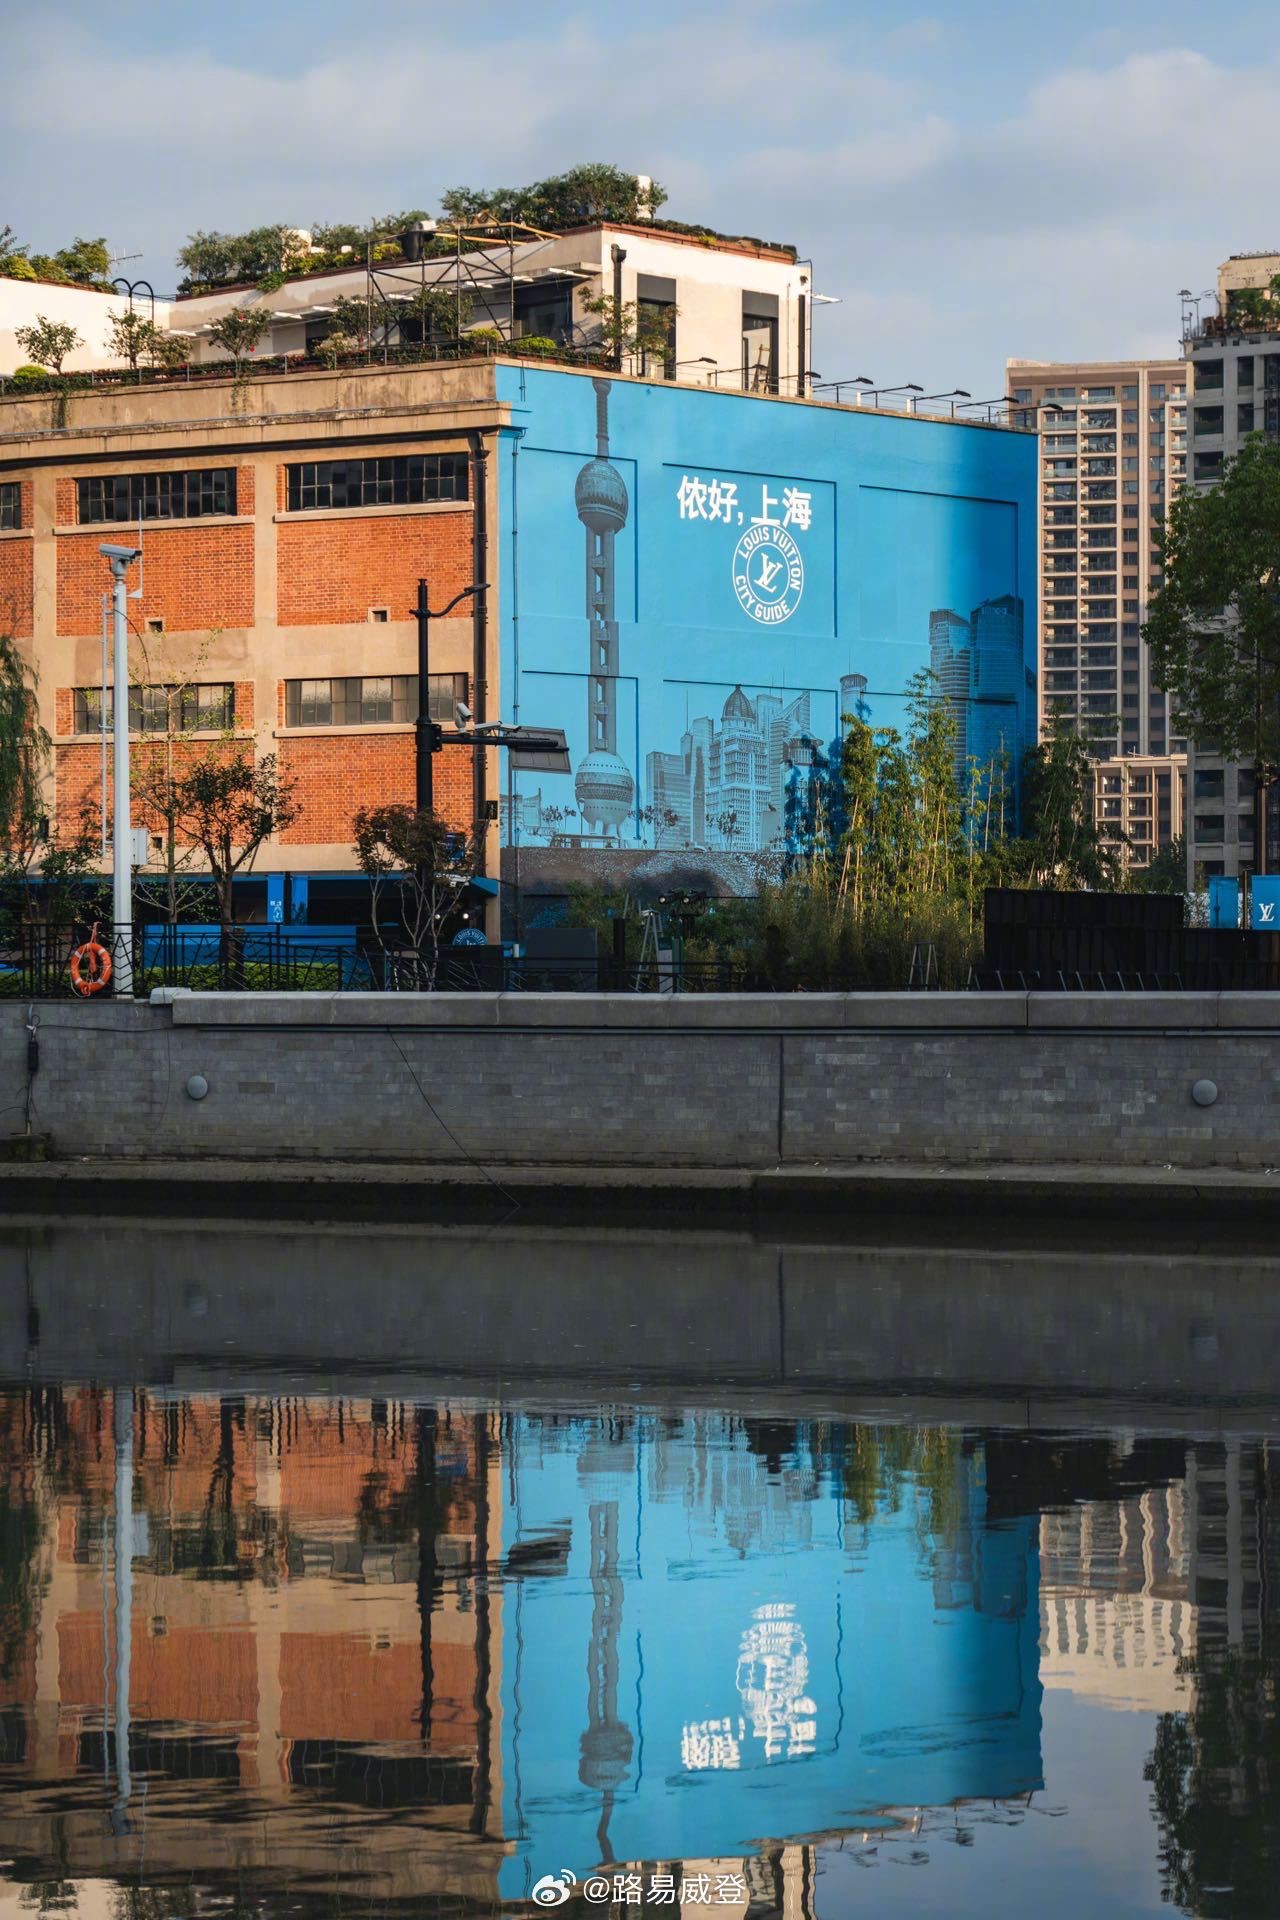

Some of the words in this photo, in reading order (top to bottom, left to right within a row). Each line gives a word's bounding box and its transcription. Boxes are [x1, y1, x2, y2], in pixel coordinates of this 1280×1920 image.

[738, 528, 770, 560] LOUIS
[773, 528, 802, 591] VUITTON
[736, 575, 756, 609] CITY
[754, 600, 790, 621] GUIDE
